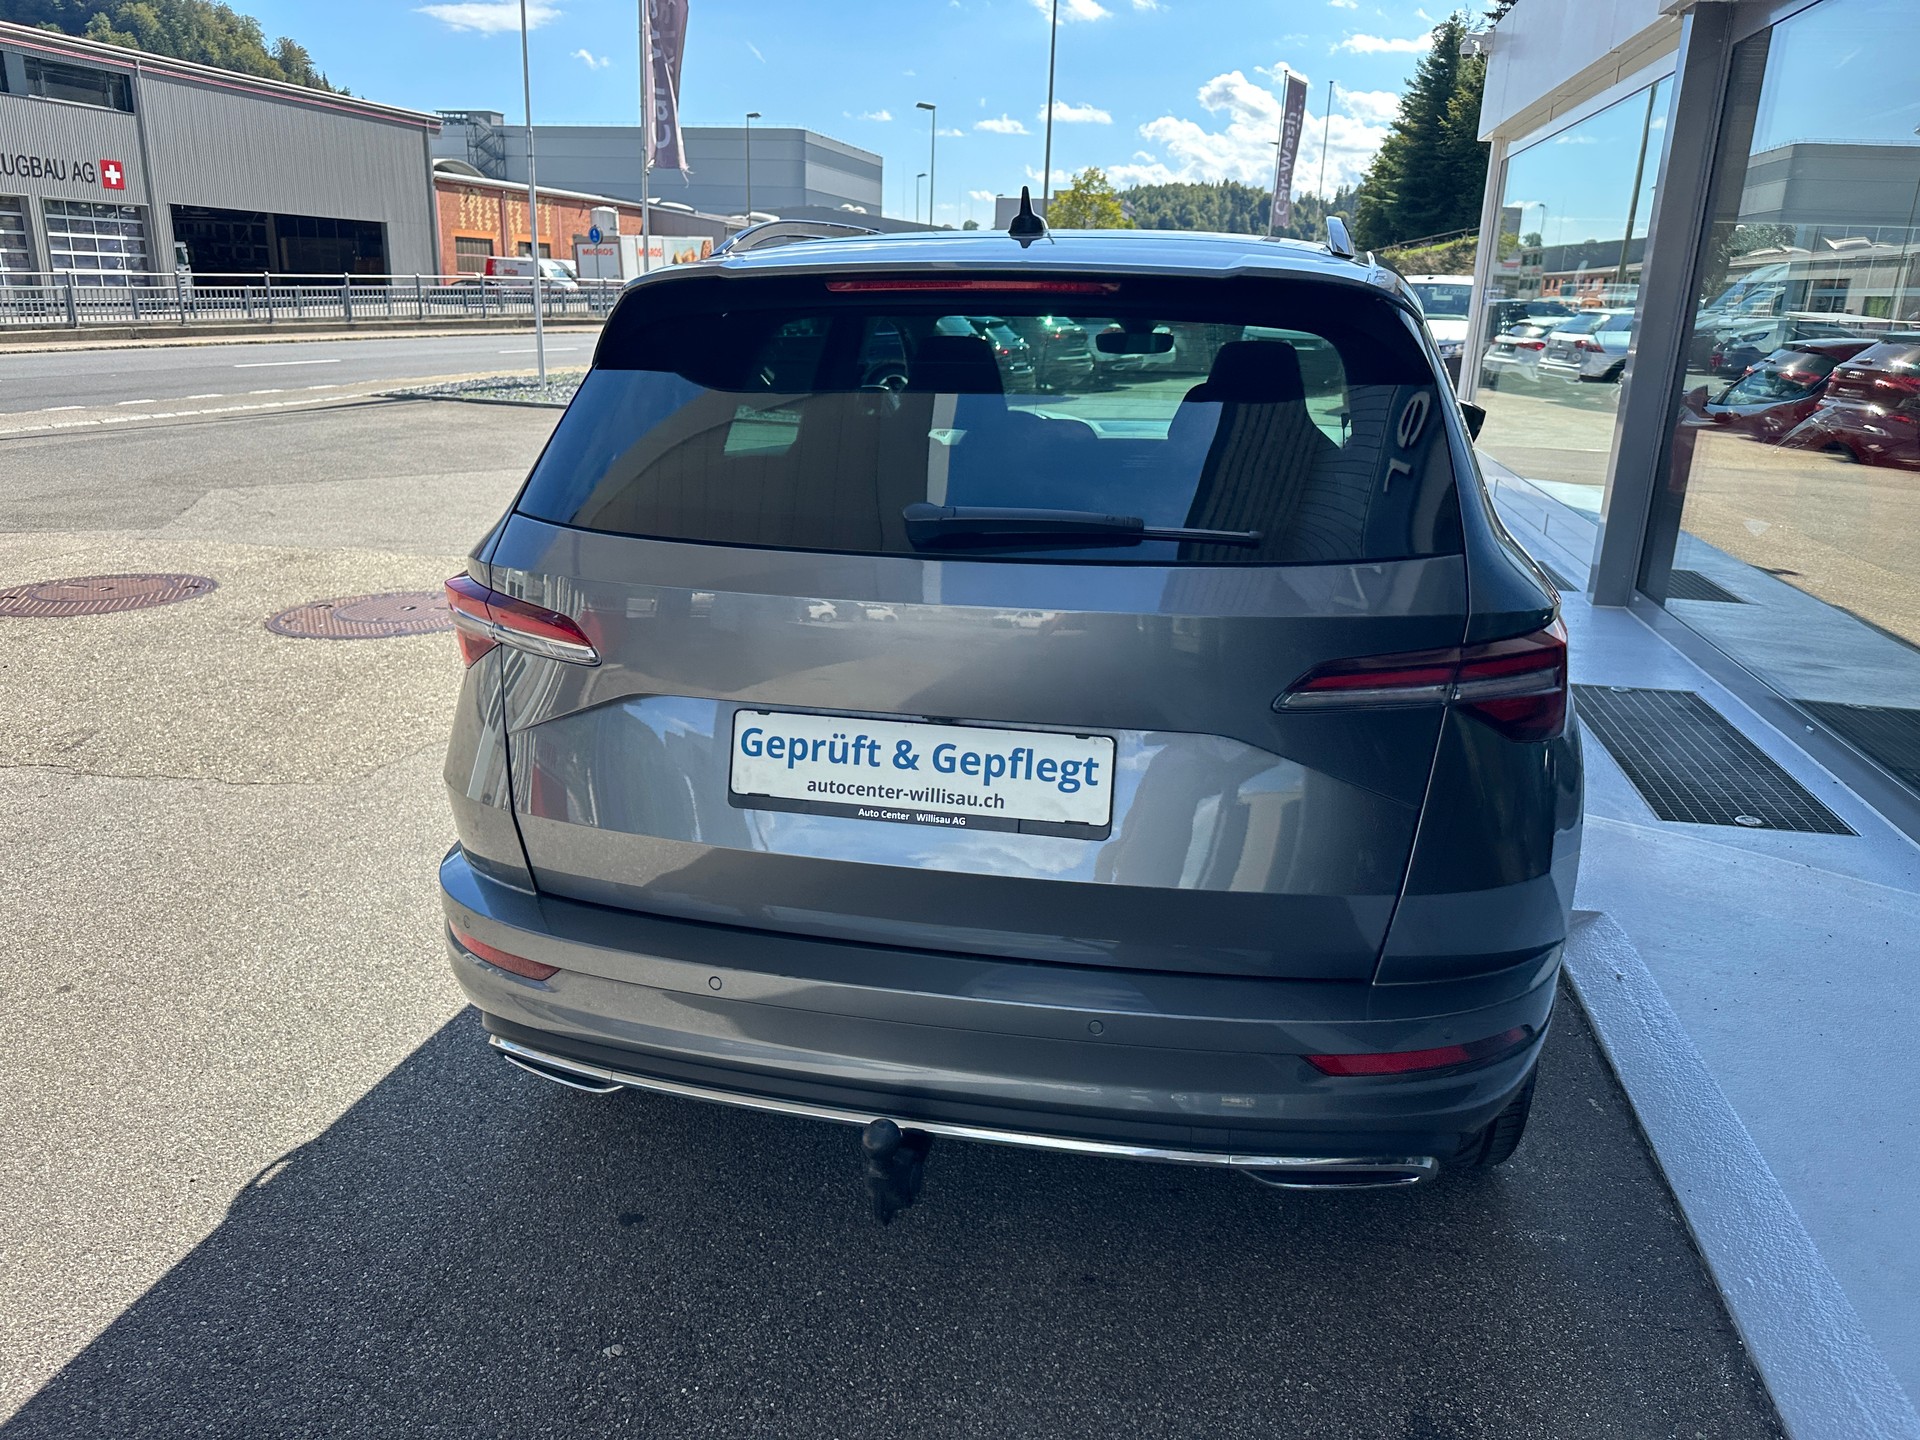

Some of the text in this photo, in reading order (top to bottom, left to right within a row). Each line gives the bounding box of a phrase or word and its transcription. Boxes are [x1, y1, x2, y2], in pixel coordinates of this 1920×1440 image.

[0, 153, 96, 183] UGBAU AG
[1275, 111, 1298, 216] Car-Wash
[116, 258, 123, 269] 2
[740, 727, 1100, 793] Geprüft & Gepflegt
[807, 778, 1005, 809] autocenter-willisau.ch
[858, 807, 967, 826] Auto Center Willisau AG
